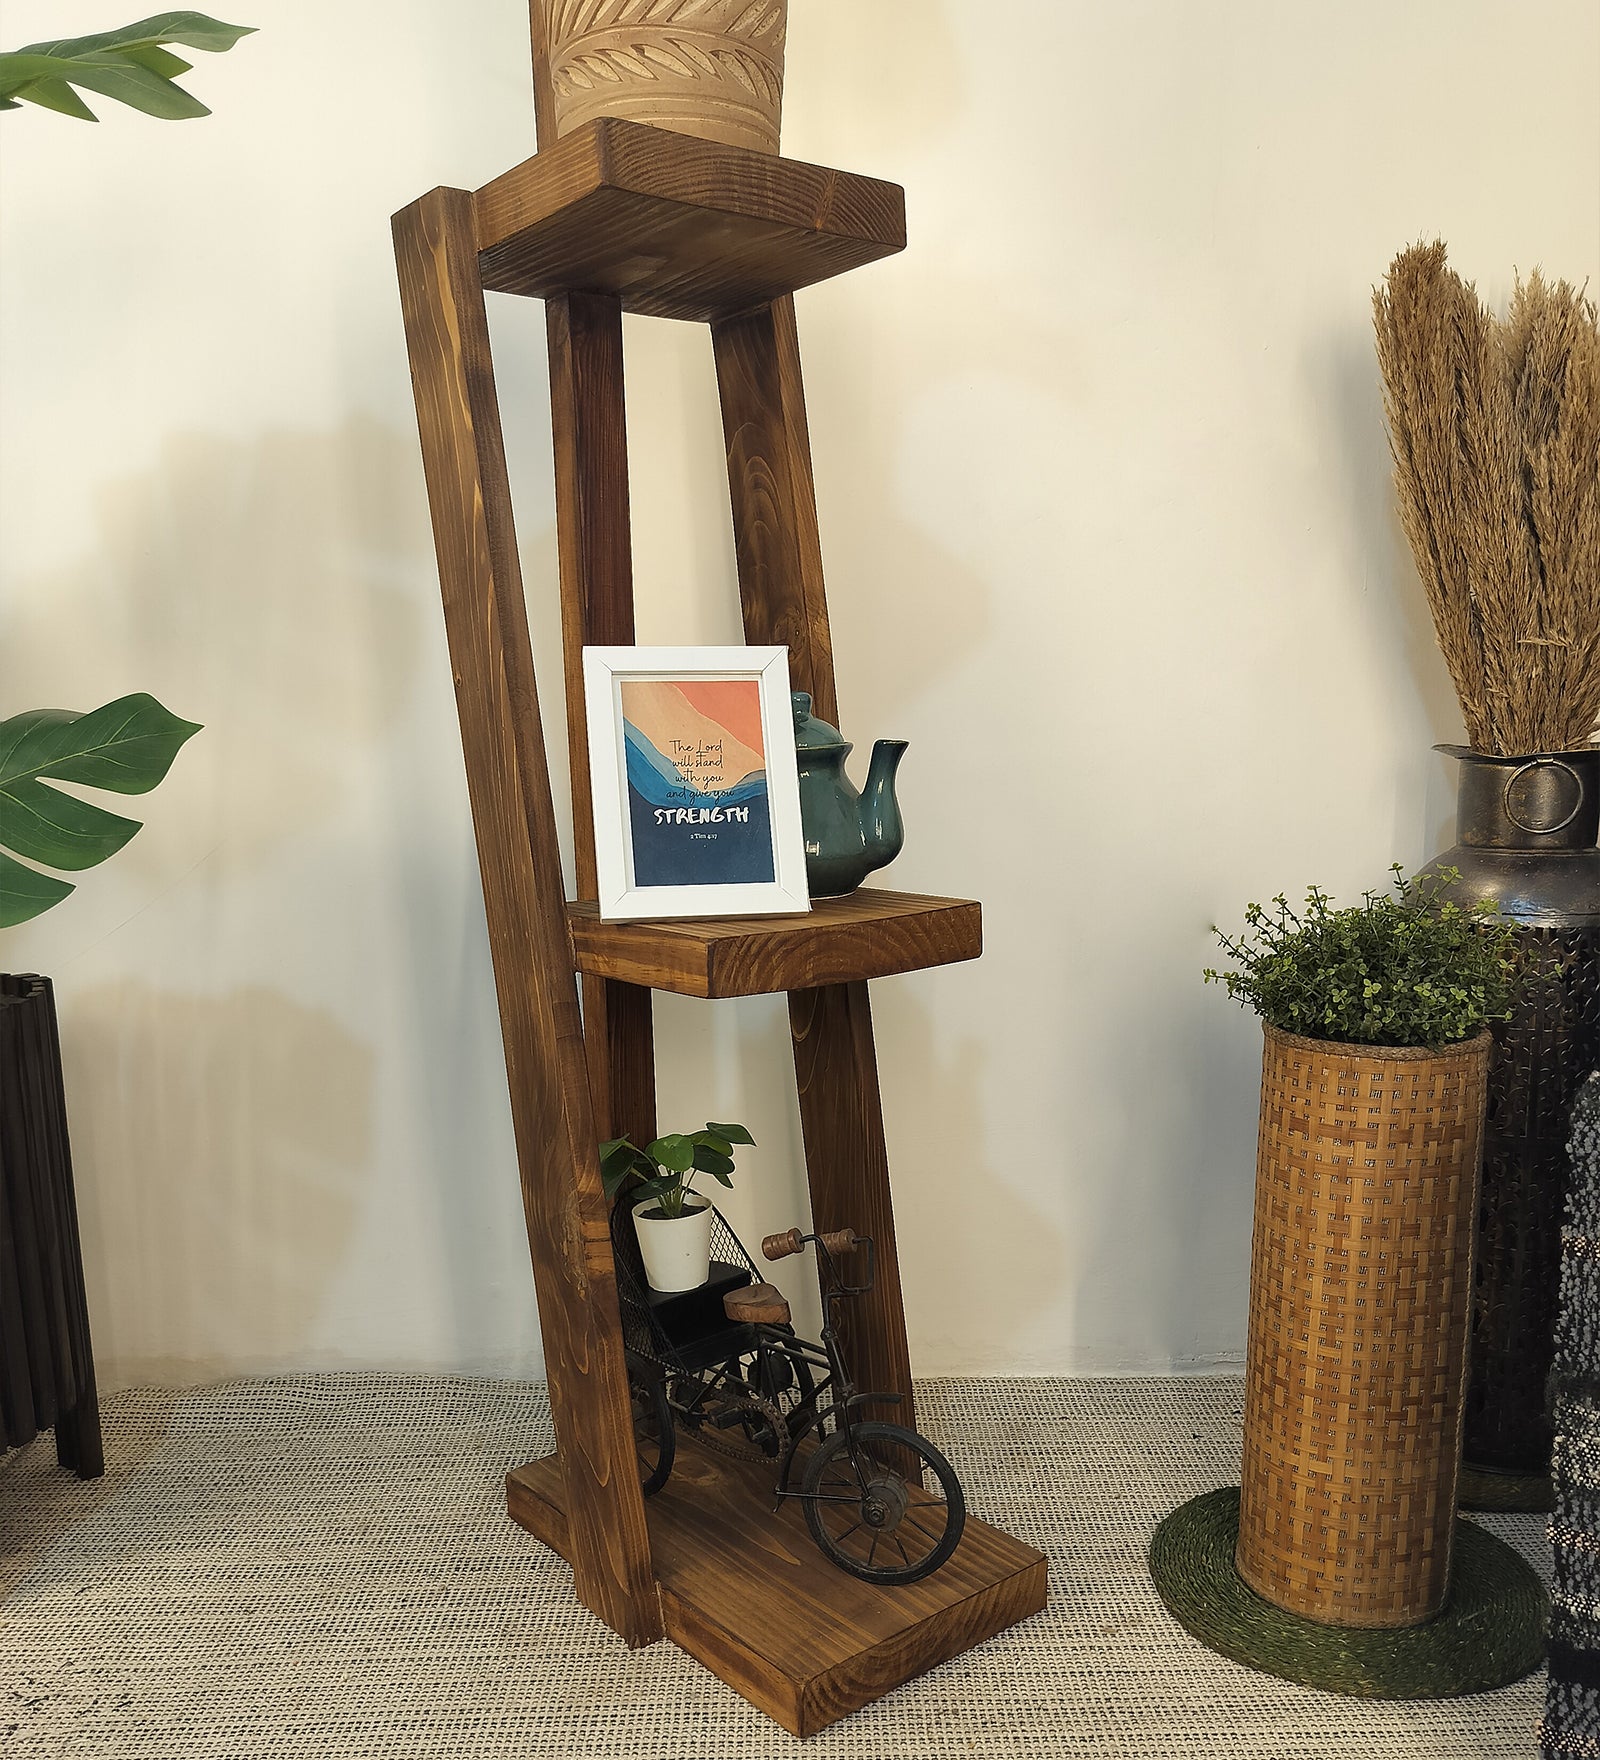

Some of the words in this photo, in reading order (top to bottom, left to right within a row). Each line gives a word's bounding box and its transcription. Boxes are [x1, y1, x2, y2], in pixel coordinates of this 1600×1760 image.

[669, 739, 694, 754] The
[695, 739, 723, 754] Lord
[672, 755, 694, 767] will
[695, 753, 724, 769] stand
[675, 768, 701, 782] with
[702, 775, 724, 790] you
[666, 786, 687, 800] and
[689, 788, 710, 806] give
[713, 789, 735, 805] you
[653, 806, 750, 825] STRENGTH
